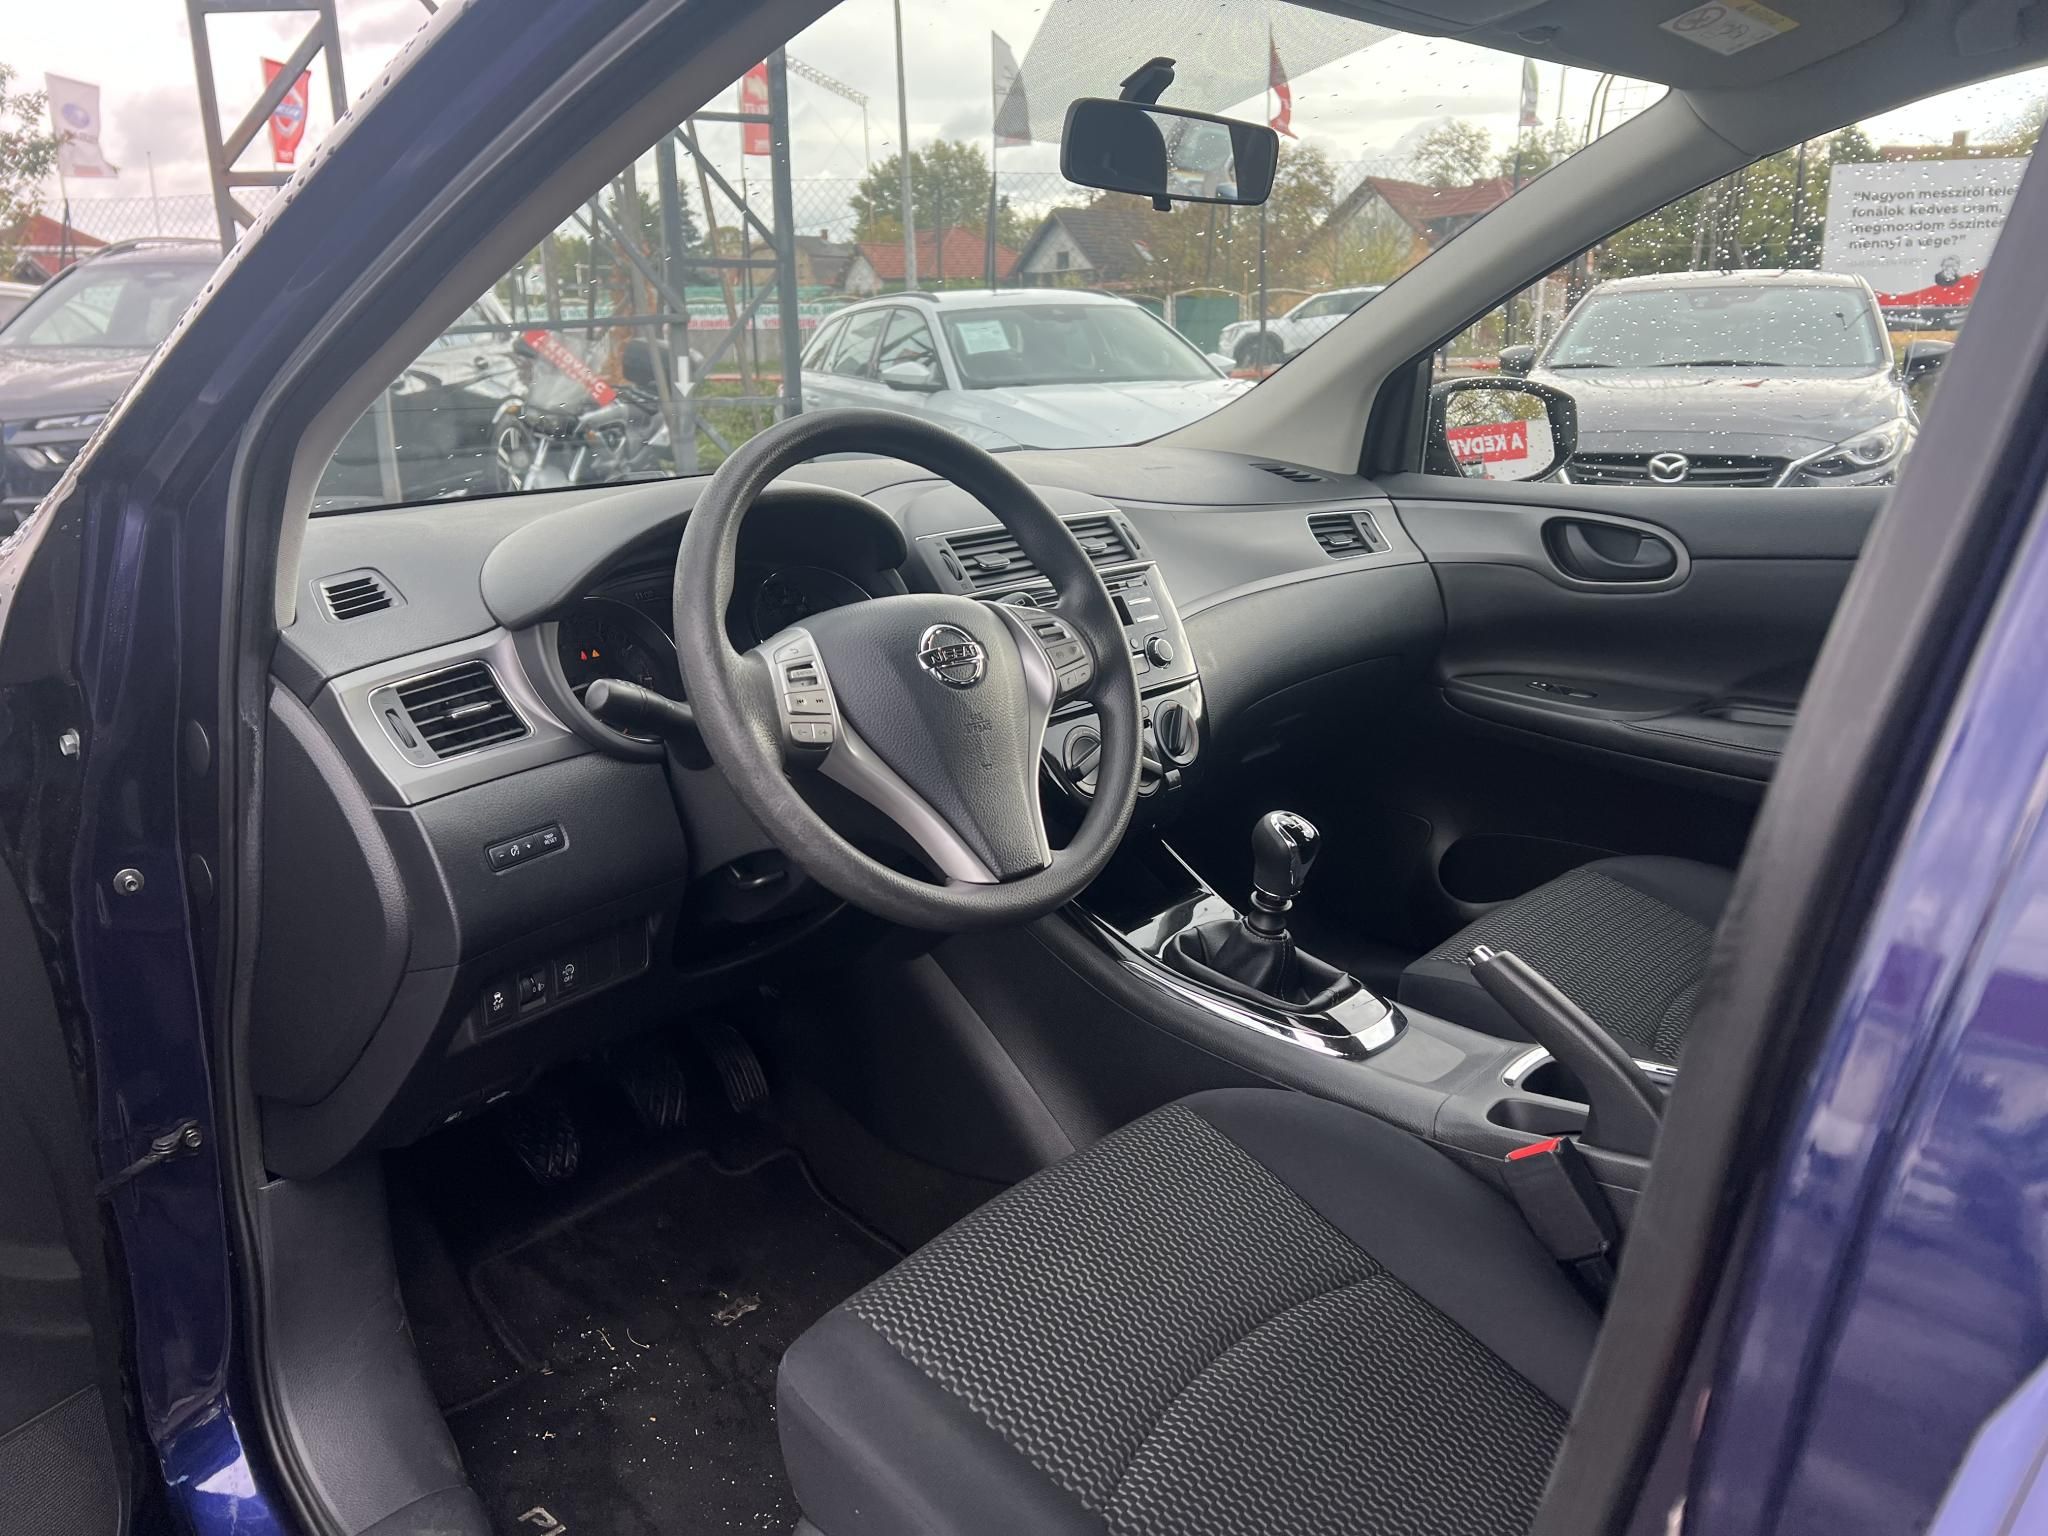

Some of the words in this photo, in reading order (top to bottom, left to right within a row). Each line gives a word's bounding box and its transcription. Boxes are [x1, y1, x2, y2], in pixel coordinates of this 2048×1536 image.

[1909, 203, 1959, 216] kedves
[1905, 238, 1913, 248] a
[929, 643, 979, 664] NISSAN
[493, 1002, 504, 1012] OFF
